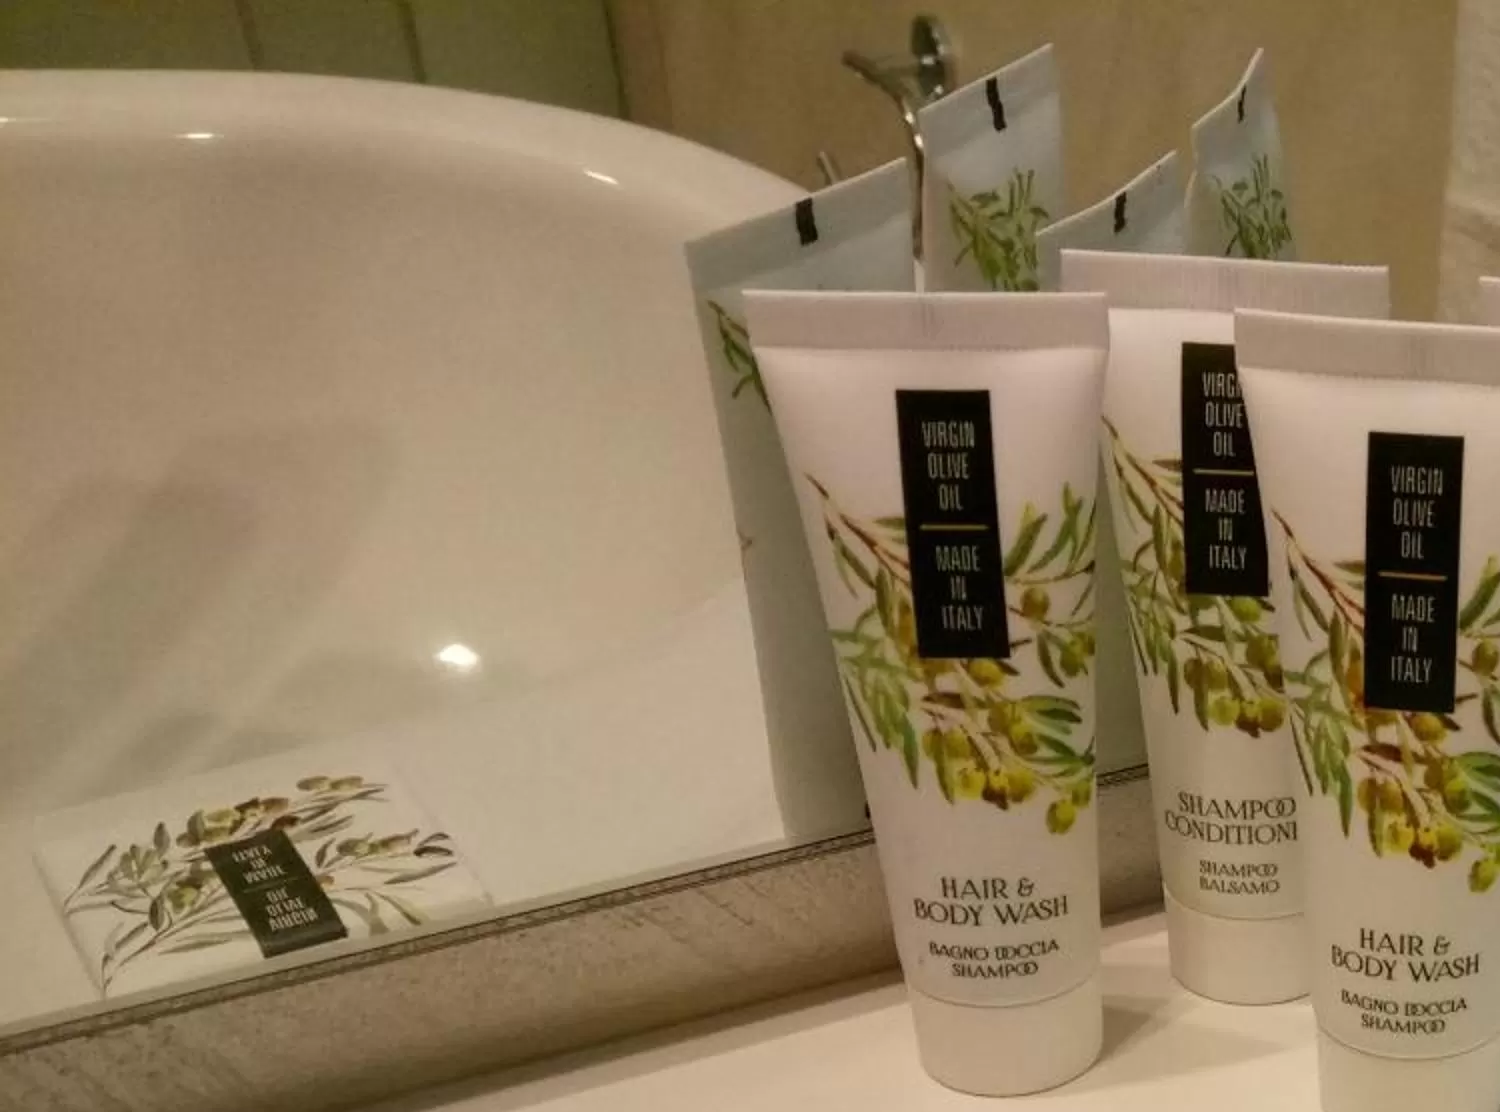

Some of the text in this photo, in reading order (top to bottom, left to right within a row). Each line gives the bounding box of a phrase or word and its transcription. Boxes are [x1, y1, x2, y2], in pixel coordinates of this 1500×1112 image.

[1205, 401, 1244, 428] OLIVE
[921, 420, 975, 448] VIRGIN
[1213, 432, 1236, 457] OIL
[927, 452, 970, 479] OLIVE
[1391, 465, 1444, 495] VIRGIN
[939, 484, 964, 511] OIL
[1205, 488, 1245, 514] MADE
[1393, 498, 1435, 528] OLIVE
[1218, 517, 1233, 542] IN
[935, 545, 981, 572] MADE
[1208, 544, 1248, 570] ITALY
[1401, 531, 1425, 559] OIL
[950, 575, 967, 601] IN
[941, 605, 984, 631] ITALY
[1391, 593, 1436, 622] MADE
[1402, 625, 1418, 653] IN
[1390, 656, 1432, 683] ITALY
[1178, 791, 1297, 820] SHAMPOO
[1200, 860, 1279, 877] SHAMPOO
[941, 876, 1035, 900] HAIR &
[1200, 877, 1280, 895] BALSAMO
[913, 896, 1069, 926] BODY WASH
[929, 941, 989, 960] BAGNO
[1359, 928, 1451, 956] HAIR &
[952, 962, 1039, 979] SHAMPOO
[1331, 944, 1480, 983] BODY WASH
[1341, 988, 1399, 1015] BAGNO
[1361, 1013, 1445, 1034] SHAMPOO
